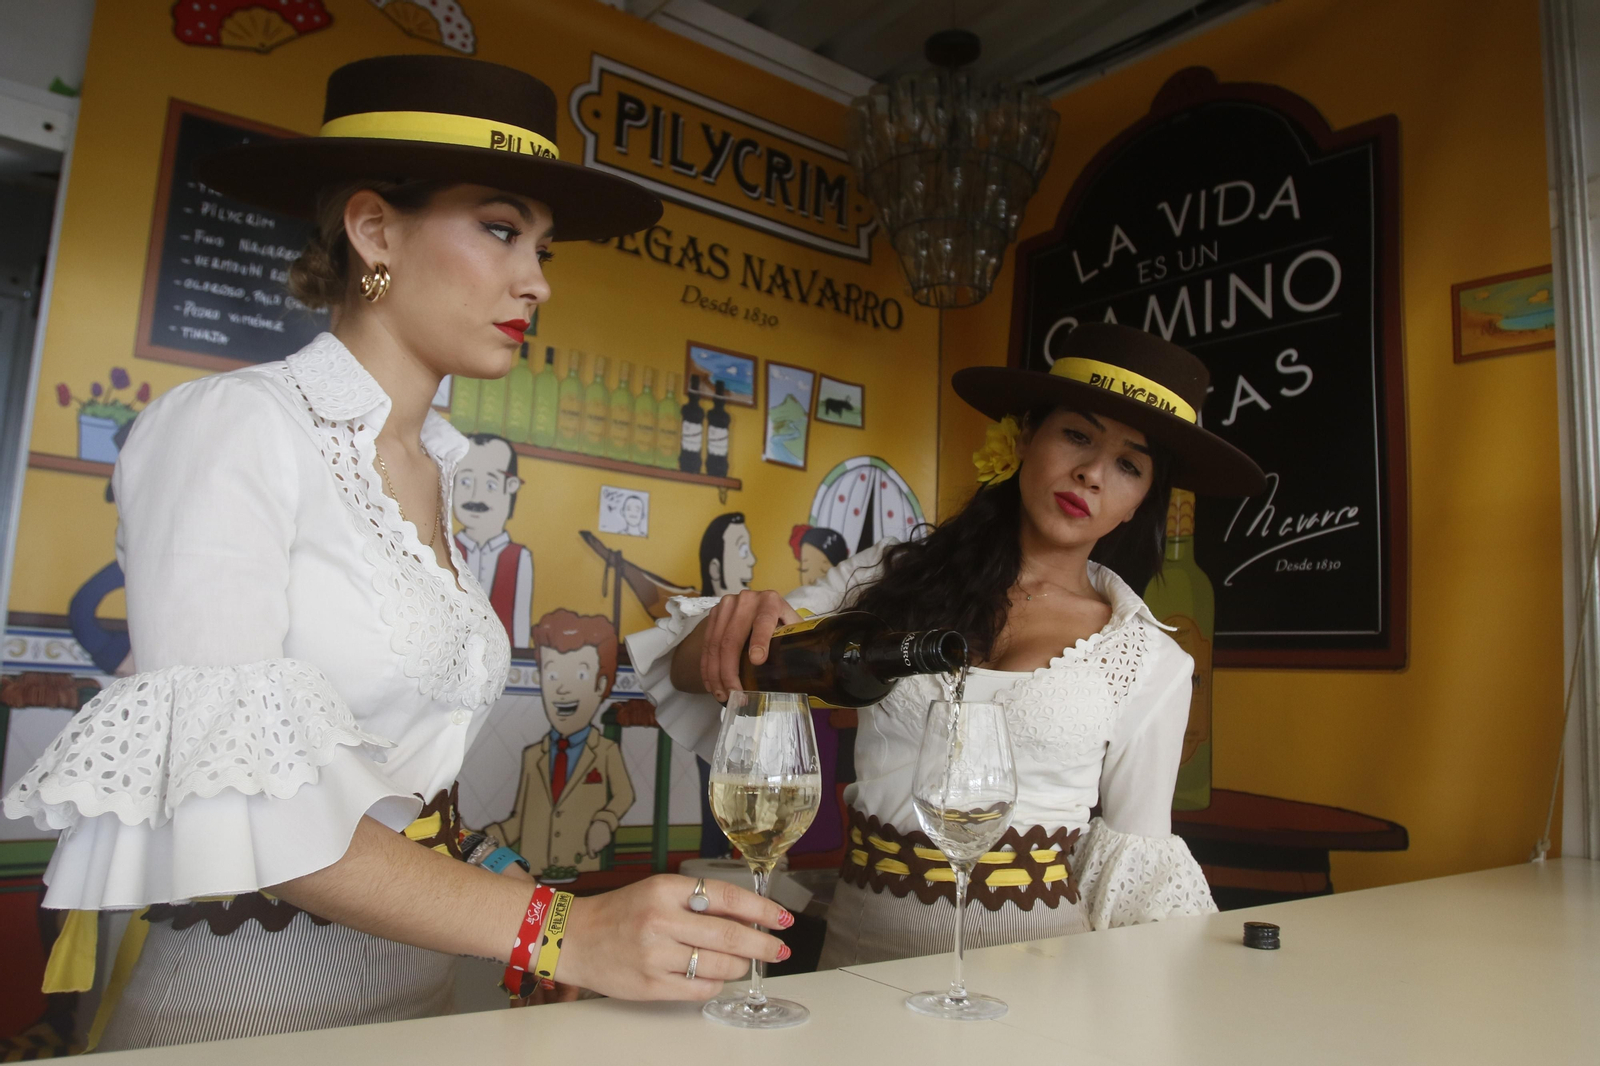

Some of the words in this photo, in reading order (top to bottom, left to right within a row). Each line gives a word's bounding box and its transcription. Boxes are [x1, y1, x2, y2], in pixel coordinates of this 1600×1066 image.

[614, 91, 849, 231] PILYCRIM
[1071, 224, 1137, 284] LA
[1157, 175, 1301, 237] VIDA
[1137, 256, 1168, 284] ES
[1178, 240, 1219, 272] UN
[589, 224, 731, 281] EGAS
[740, 252, 904, 331] NAVARRO
[680, 284, 739, 317] Desde
[743, 307, 779, 328] 1830
[1043, 249, 1342, 368] CMINO
[1275, 558, 1313, 573] Desde
[1316, 558, 1342, 572] 1830
[551, 894, 570, 930] PILYCRIM
